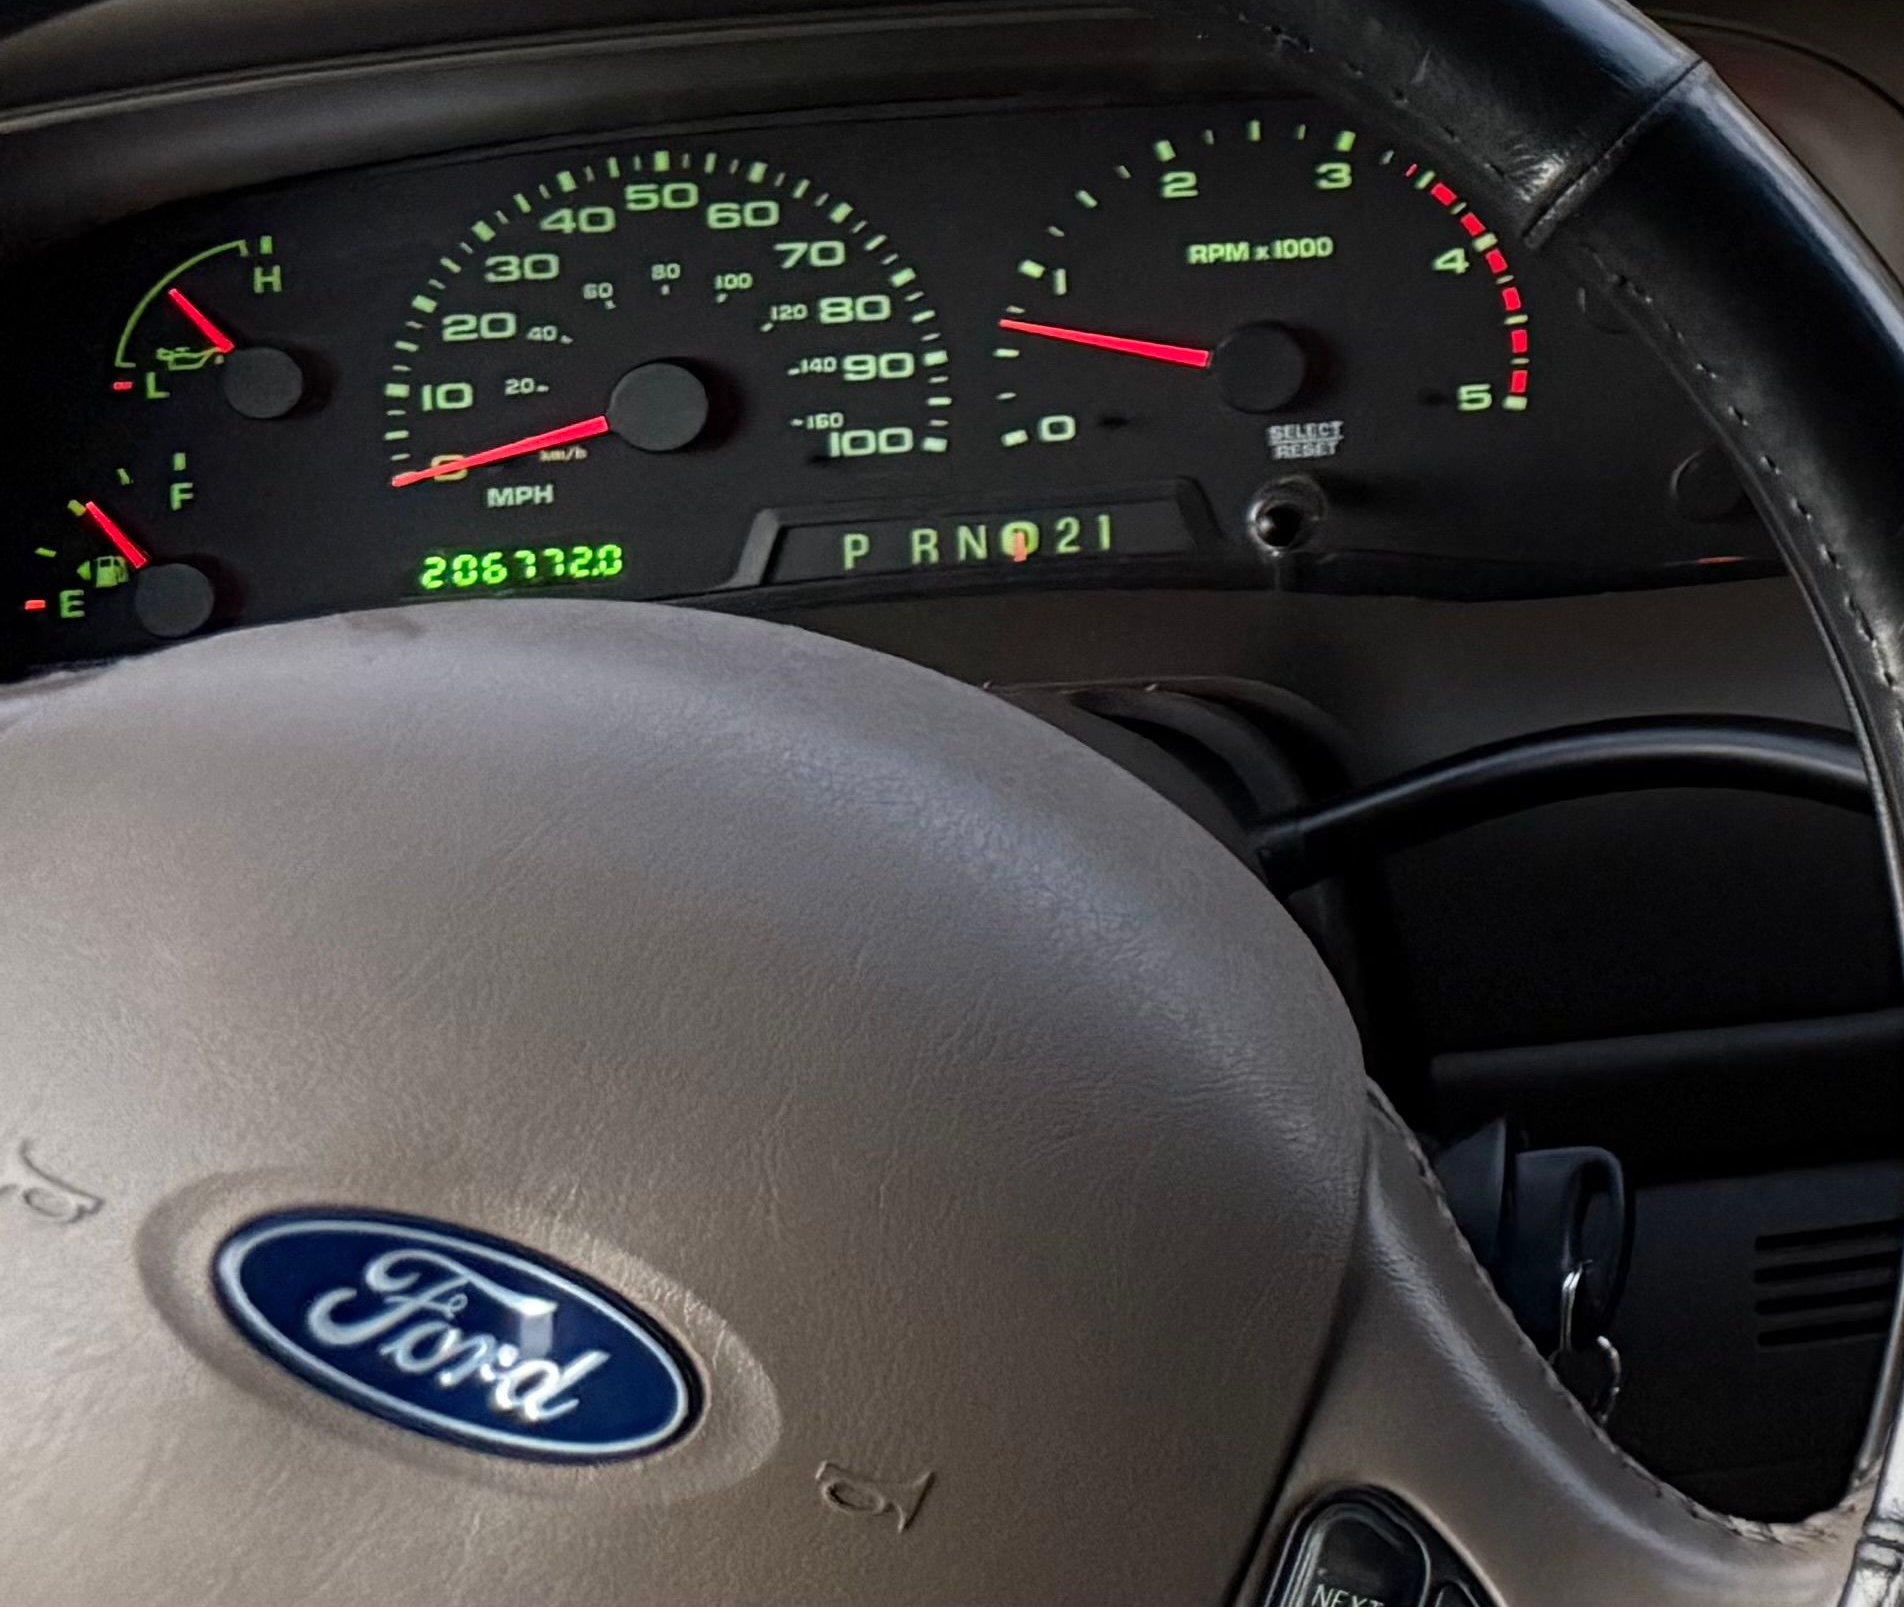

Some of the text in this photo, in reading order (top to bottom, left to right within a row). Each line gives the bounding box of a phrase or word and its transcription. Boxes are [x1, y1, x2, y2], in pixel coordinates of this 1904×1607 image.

[1162, 171, 1198, 198] 2
[1317, 162, 1352, 189] 3
[625, 182, 699, 211] 50
[540, 206, 615, 234] 40
[706, 200, 779, 229] 60
[774, 240, 845, 269] 70
[1188, 240, 1250, 266] RPM
[1433, 248, 1470, 274] 4
[253, 265, 282, 293] H
[485, 253, 559, 283] 30
[651, 263, 681, 281] 80
[715, 272, 753, 290] 100
[1054, 268, 1067, 295] 1
[583, 282, 614, 300] 60
[771, 303, 808, 321] 120
[819, 294, 891, 324] 80
[442, 312, 517, 342] 20
[526, 325, 557, 342] 40
[800, 356, 837, 373] 140
[842, 352, 915, 381] 90
[146, 371, 170, 399] L
[421, 382, 473, 411] 10
[505, 377, 535, 395] 20
[1458, 384, 1492, 411] 5
[806, 412, 844, 430] 160
[1039, 415, 1076, 442] 0
[1266, 420, 1344, 440] SELECT
[829, 427, 914, 458] 100
[431, 454, 468, 482] 0
[170, 482, 193, 510] F
[487, 484, 554, 507] MPH
[843, 533, 869, 570] P
[911, 528, 939, 564] R
[957, 524, 987, 561] N
[1055, 516, 1080, 554] 2
[1098, 514, 1110, 550] 1
[420, 544, 624, 590] 206772.0
[59, 589, 85, 618] E
[307, 1248, 610, 1422] Ford
[1311, 1583, 1385, 1607] NE
